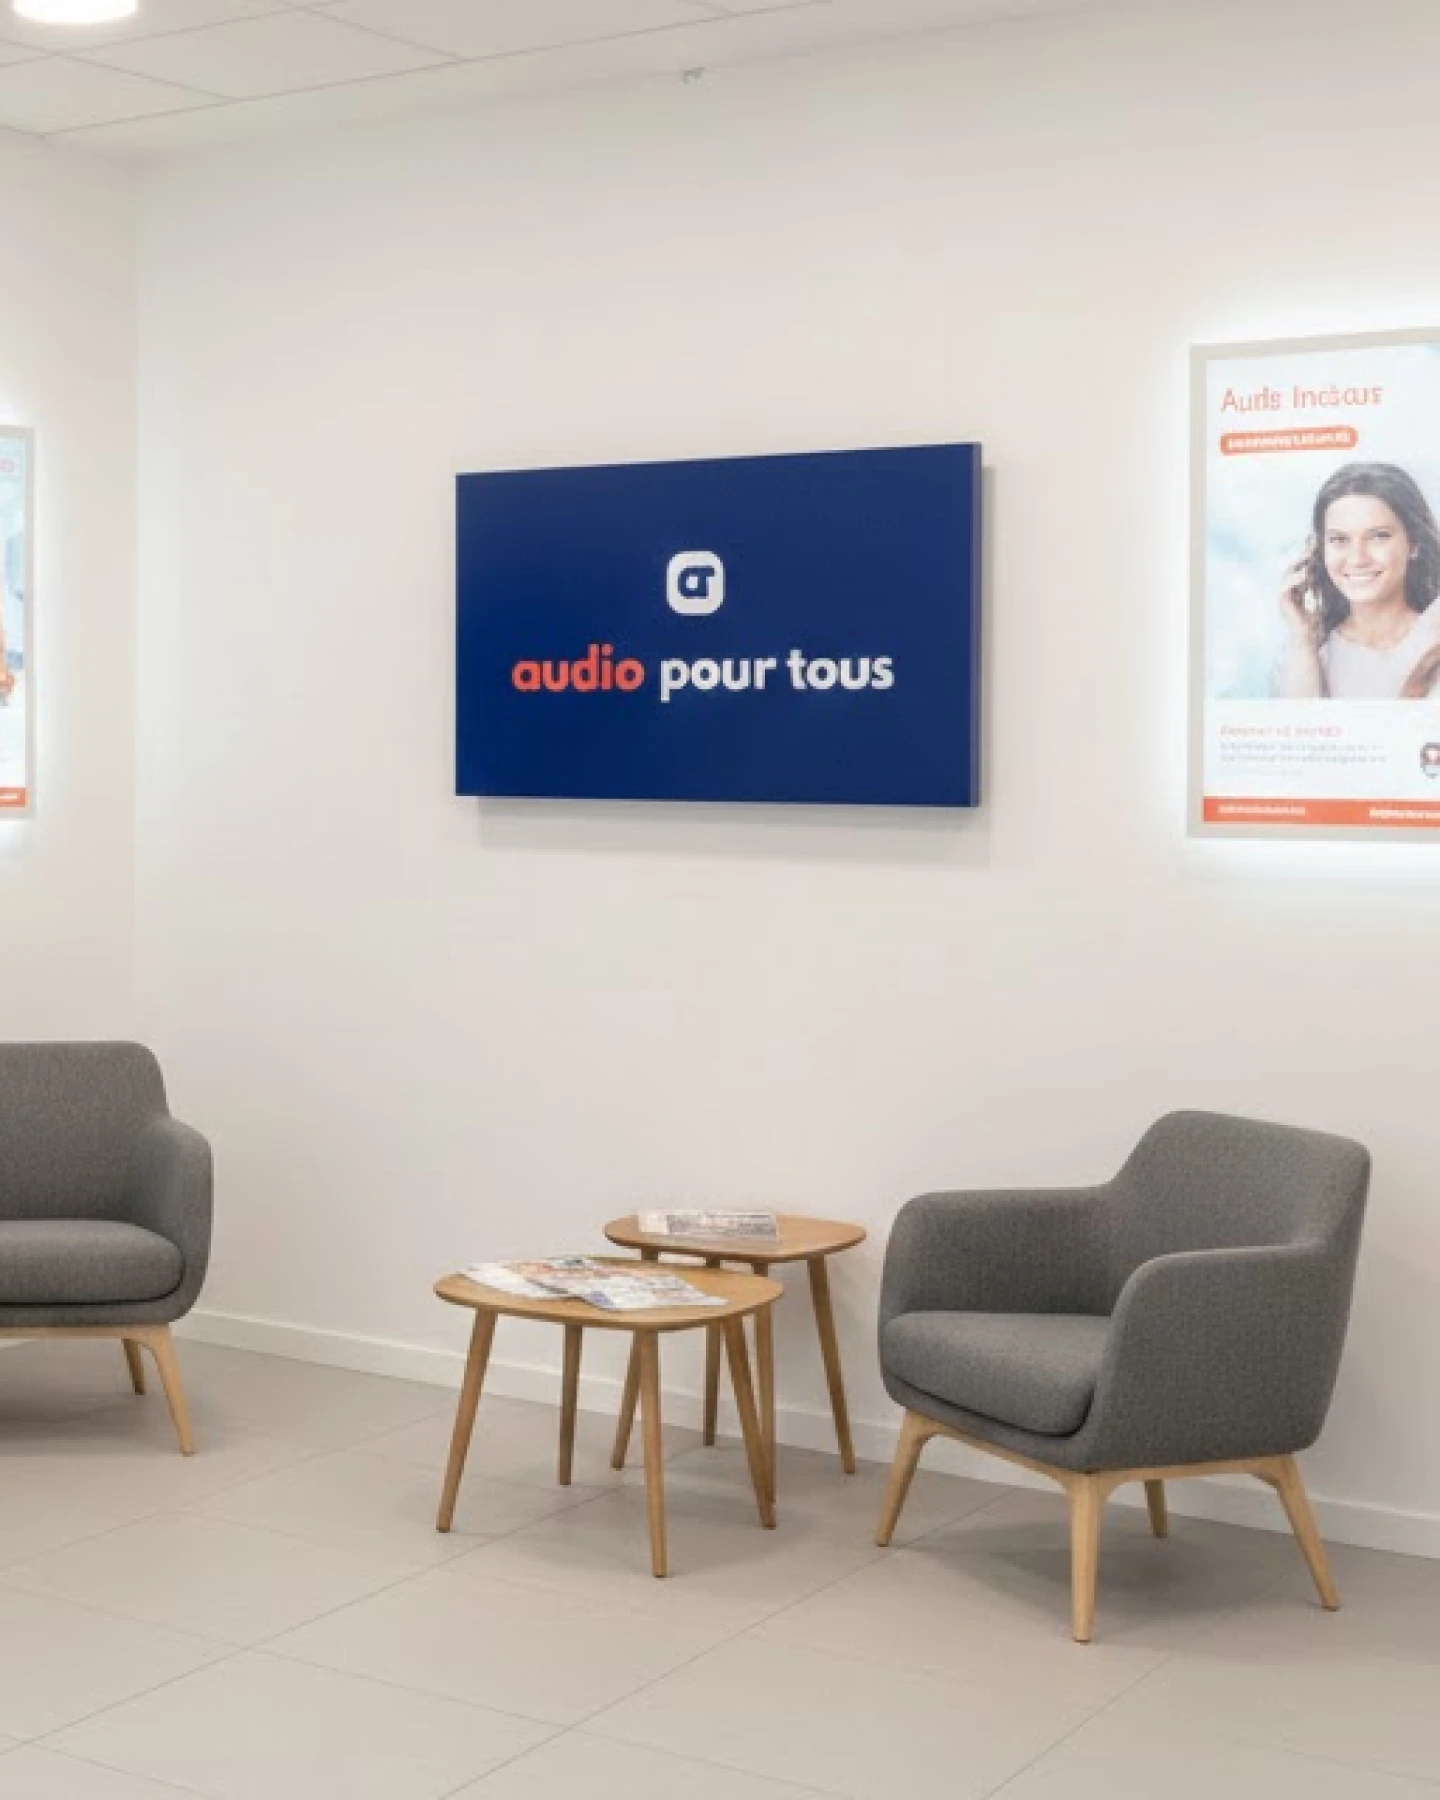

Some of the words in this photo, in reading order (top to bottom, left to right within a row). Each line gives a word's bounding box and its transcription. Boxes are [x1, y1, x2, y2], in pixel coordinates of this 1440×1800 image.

[511, 643, 645, 692] audio
[660, 657, 777, 703] pour
[786, 649, 895, 690] tous
